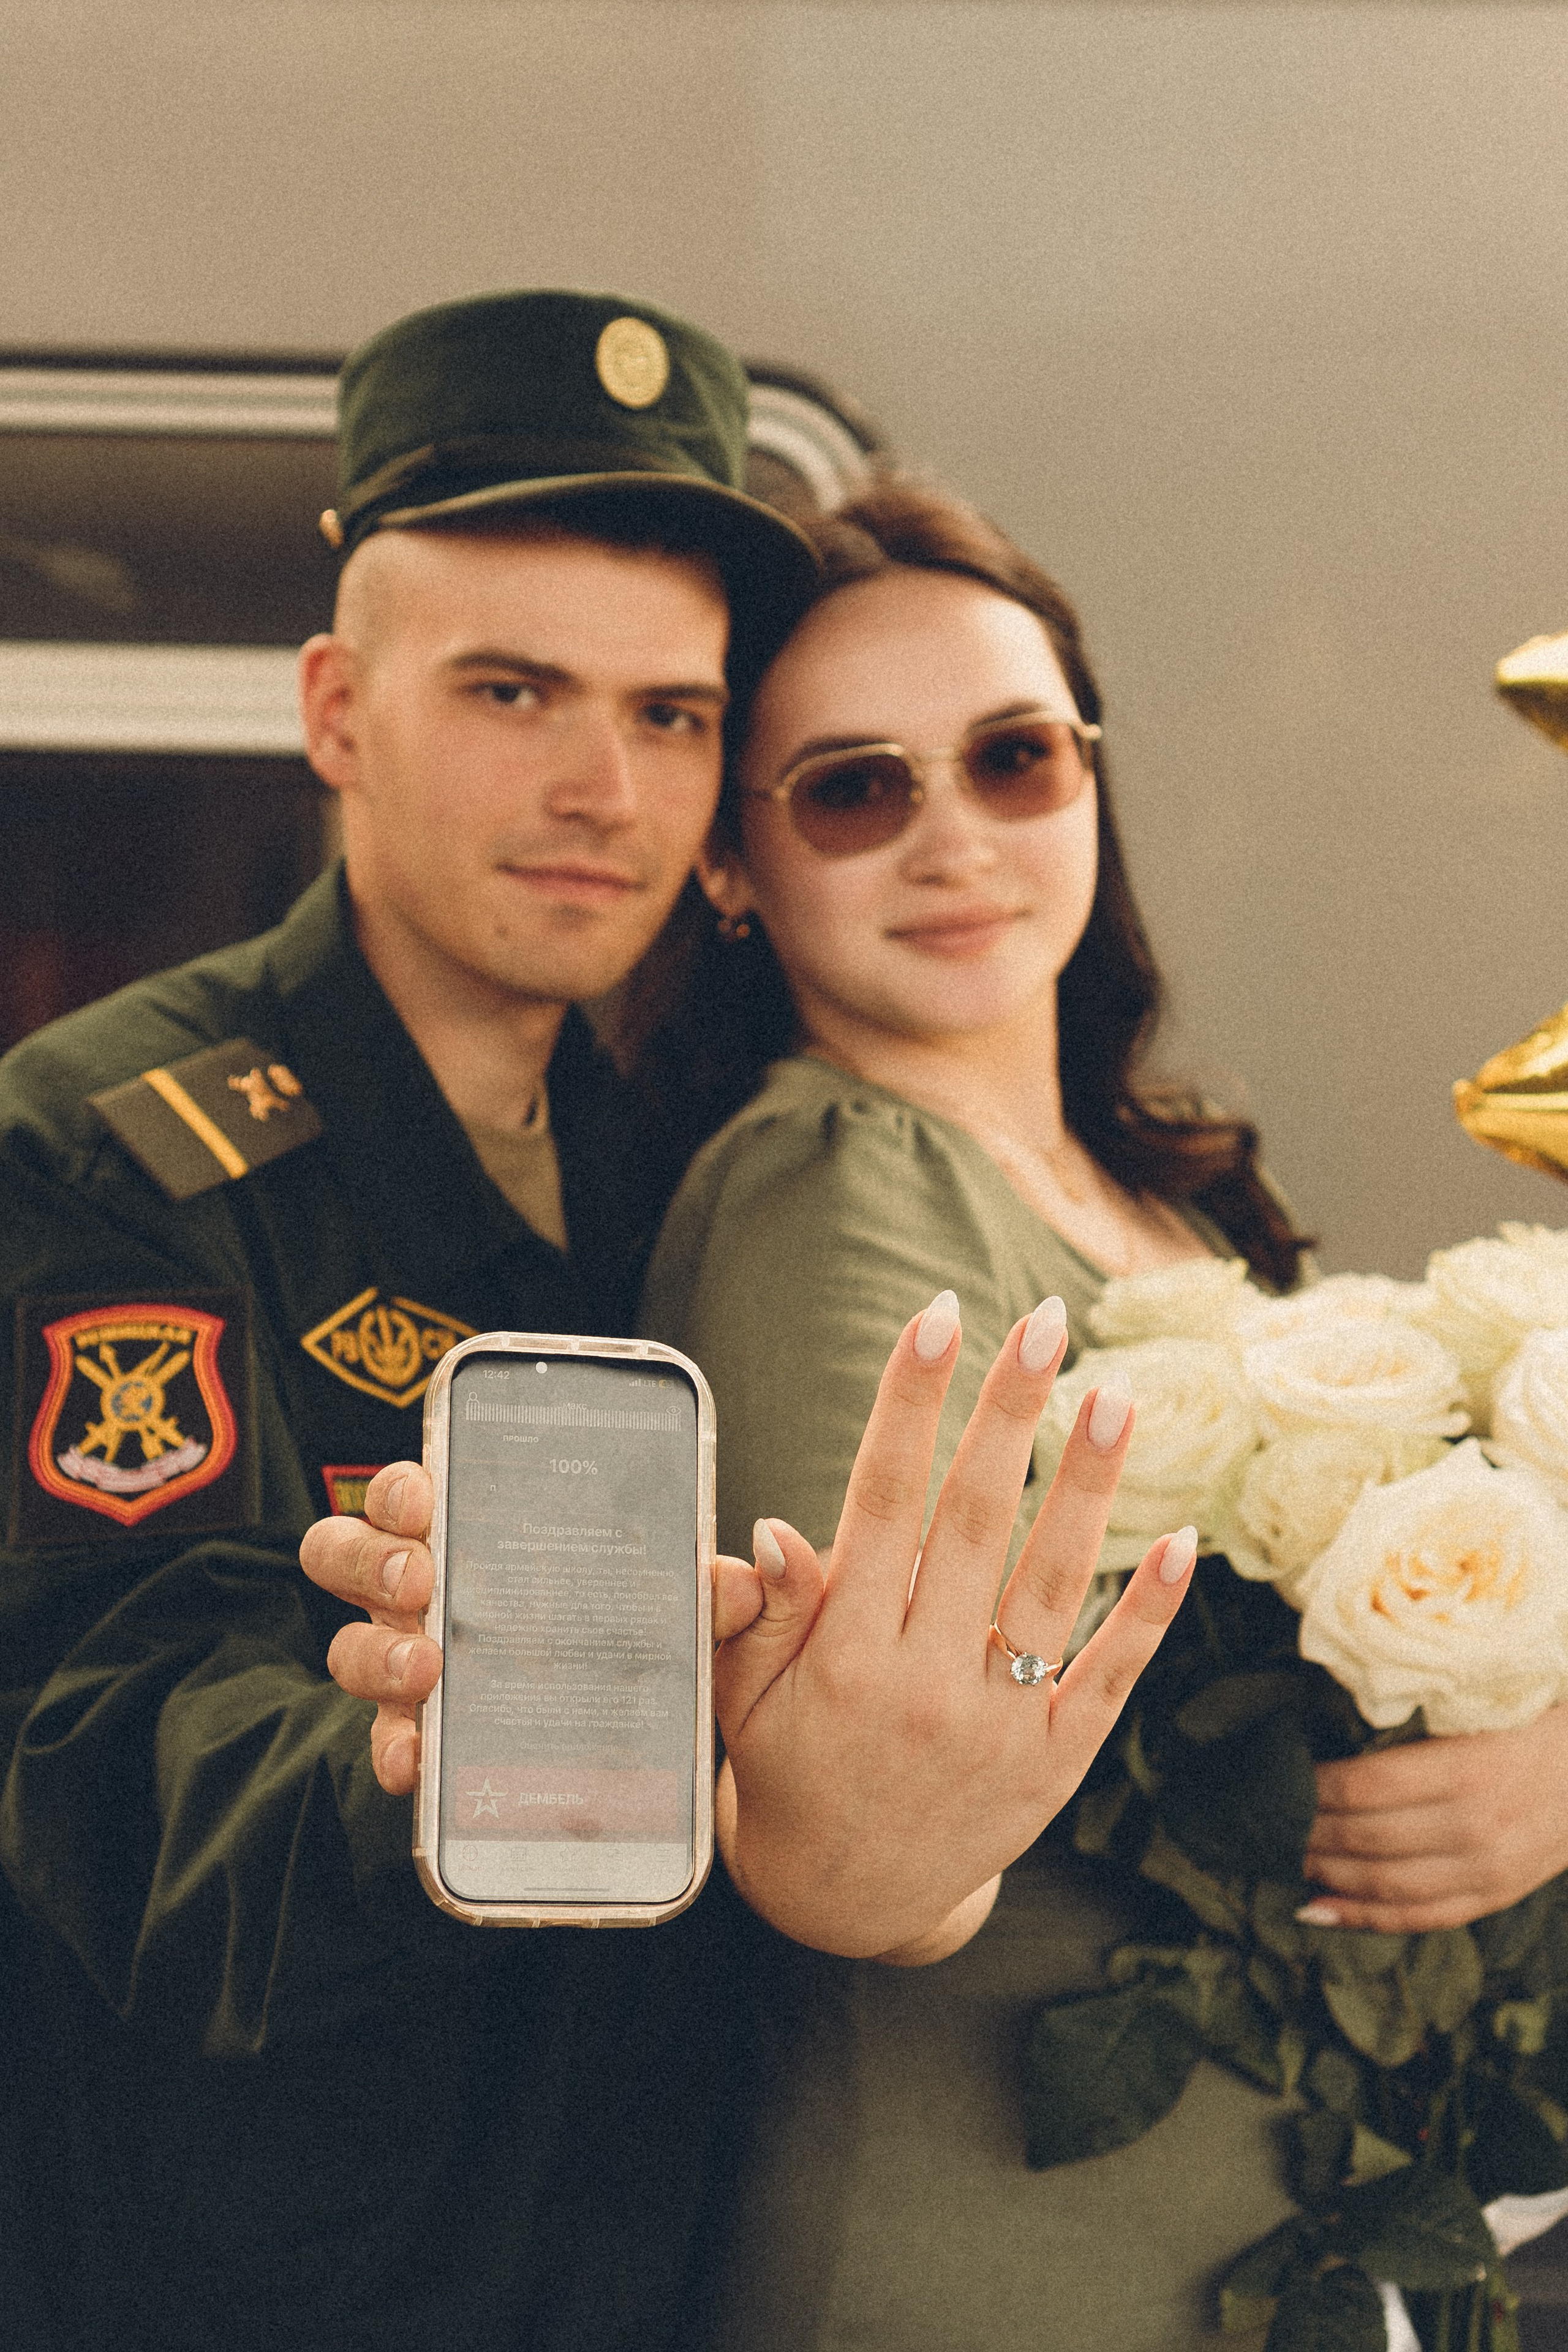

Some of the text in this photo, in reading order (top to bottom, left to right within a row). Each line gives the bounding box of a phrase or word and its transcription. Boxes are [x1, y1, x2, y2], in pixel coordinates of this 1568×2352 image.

[483, 1370, 510, 1380] 12:42
[502, 1434, 539, 1443] прошло
[549, 1458, 598, 1476] 100%
[522, 1523, 623, 1538] Поздравляем с
[497, 1540, 646, 1556] завершением службы!
[466, 1561, 503, 1572] Пройдя
[505, 1562, 560, 1574] армейскую
[563, 1566, 595, 1575] школу,
[616, 1568, 676, 1578] несомненно,
[531, 1577, 574, 1587] сильнее,
[576, 1578, 628, 1588] увереннее
[462, 1586, 571, 1599] дисциплинированнее,
[613, 1591, 660, 1602] приобрел
[480, 1599, 527, 1609] качества,
[529, 1600, 568, 1610] нужные
[590, 1603, 613, 1612] того,
[616, 1604, 645, 1612] чтобы
[474, 1610, 512, 1620] мирной
[548, 1613, 582, 1622] шагать
[592, 1615, 628, 1624] первых
[630, 1616, 658, 1625] рядах
[495, 1624, 538, 1634] надежно
[540, 1626, 579, 1634] хранить
[606, 1627, 646, 1636] счастье!
[478, 1634, 545, 1645] Поздравляем
[555, 1638, 614, 1647] окончанием
[616, 1640, 654, 1649] службы
[468, 1647, 507, 1656] желаем
[508, 1648, 551, 1657] большой
[554, 1649, 585, 1658] любви
[596, 1651, 625, 1660] удачи
[635, 1652, 672, 1661] мирной
[491, 1679, 502, 1689] За
[505, 1681, 535, 1691] время
[538, 1682, 611, 1692] использования
[480, 1693, 541, 1702] приложения
[559, 1695, 600, 1704] открыли
[621, 1695, 636, 1705] 121
[469, 1703, 514, 1714] Спасибо,
[536, 1705, 561, 1714] были
[571, 1708, 600, 1717] нами,
[610, 1708, 647, 1717] желаем
[494, 1717, 532, 1726] счастья
[543, 1719, 573, 1728] удачи
[588, 1720, 644, 1729] гражданке!
[518, 1792, 584, 1806] ДЕМБЕЛЬ
